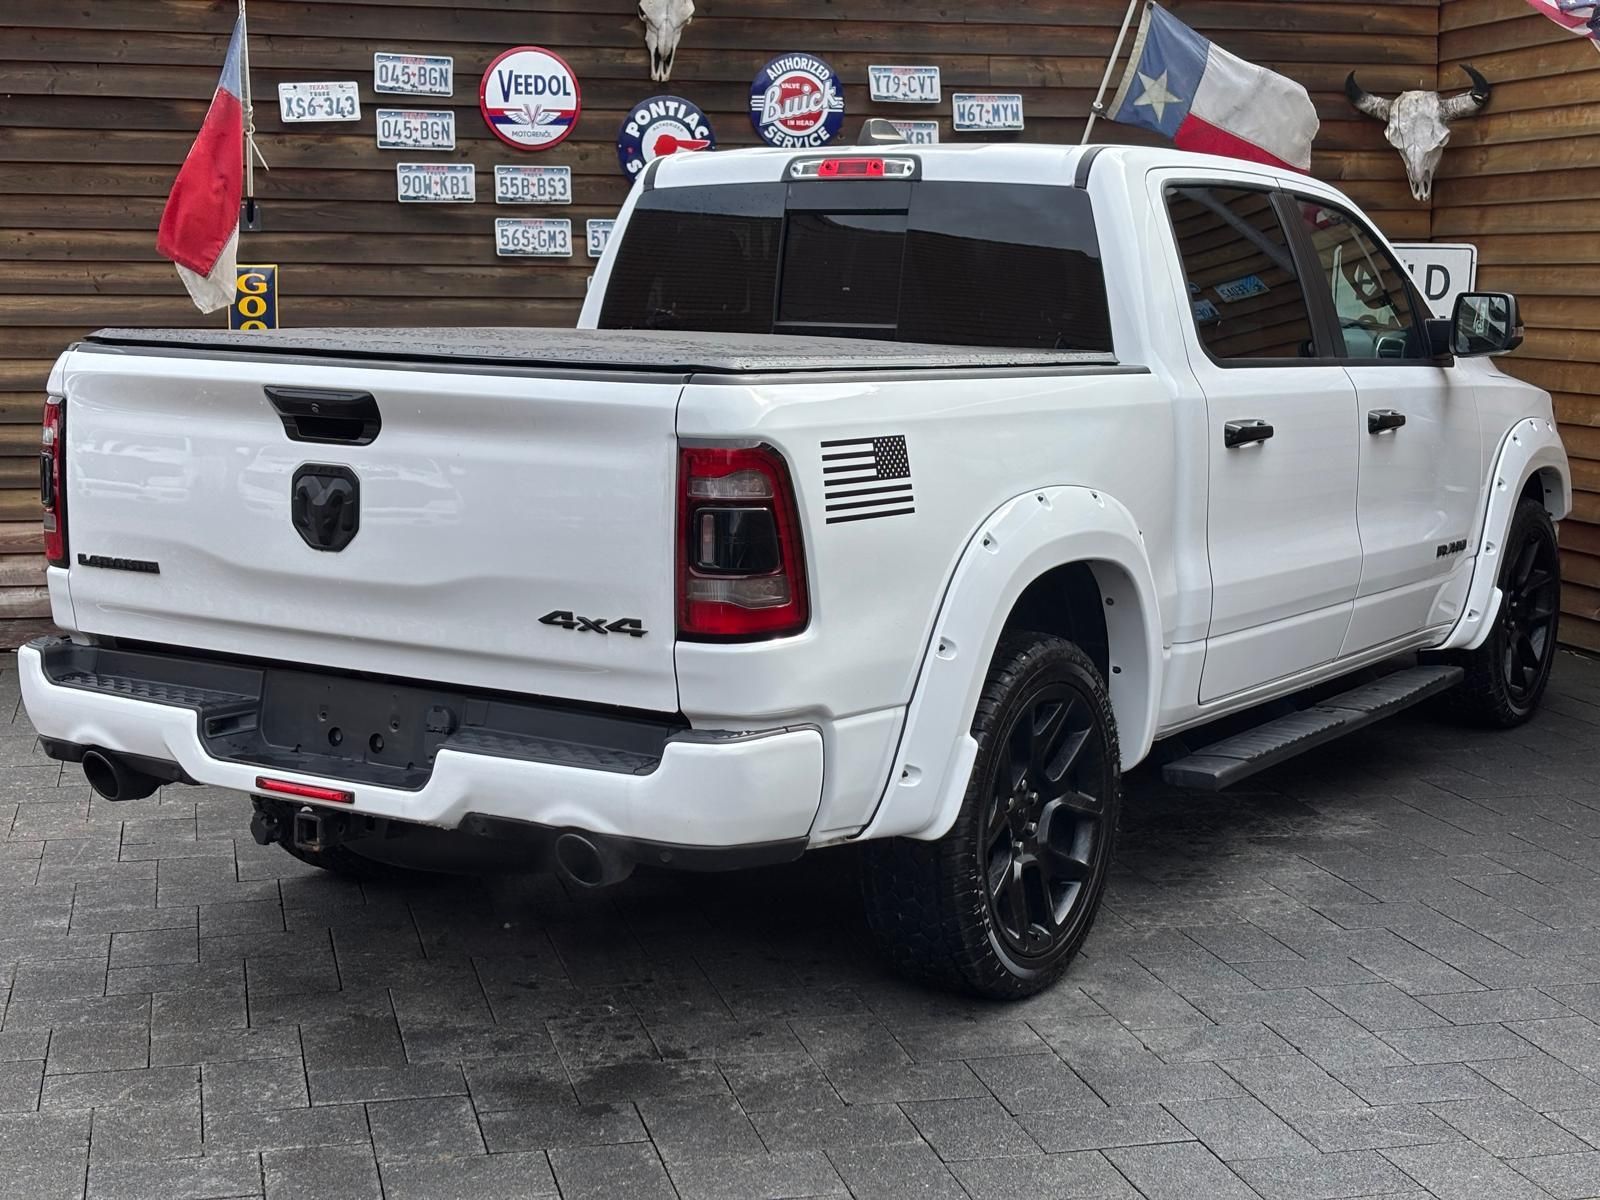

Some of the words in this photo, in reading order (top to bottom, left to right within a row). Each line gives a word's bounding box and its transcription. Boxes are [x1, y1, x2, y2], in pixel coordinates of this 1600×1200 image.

[766, 57, 830, 80] AUTHORIZED
[498, 69, 571, 102] VEEDOL
[760, 79, 840, 126] Buick
[625, 101, 709, 139] PONTIAC
[764, 125, 830, 148] SERVICE
